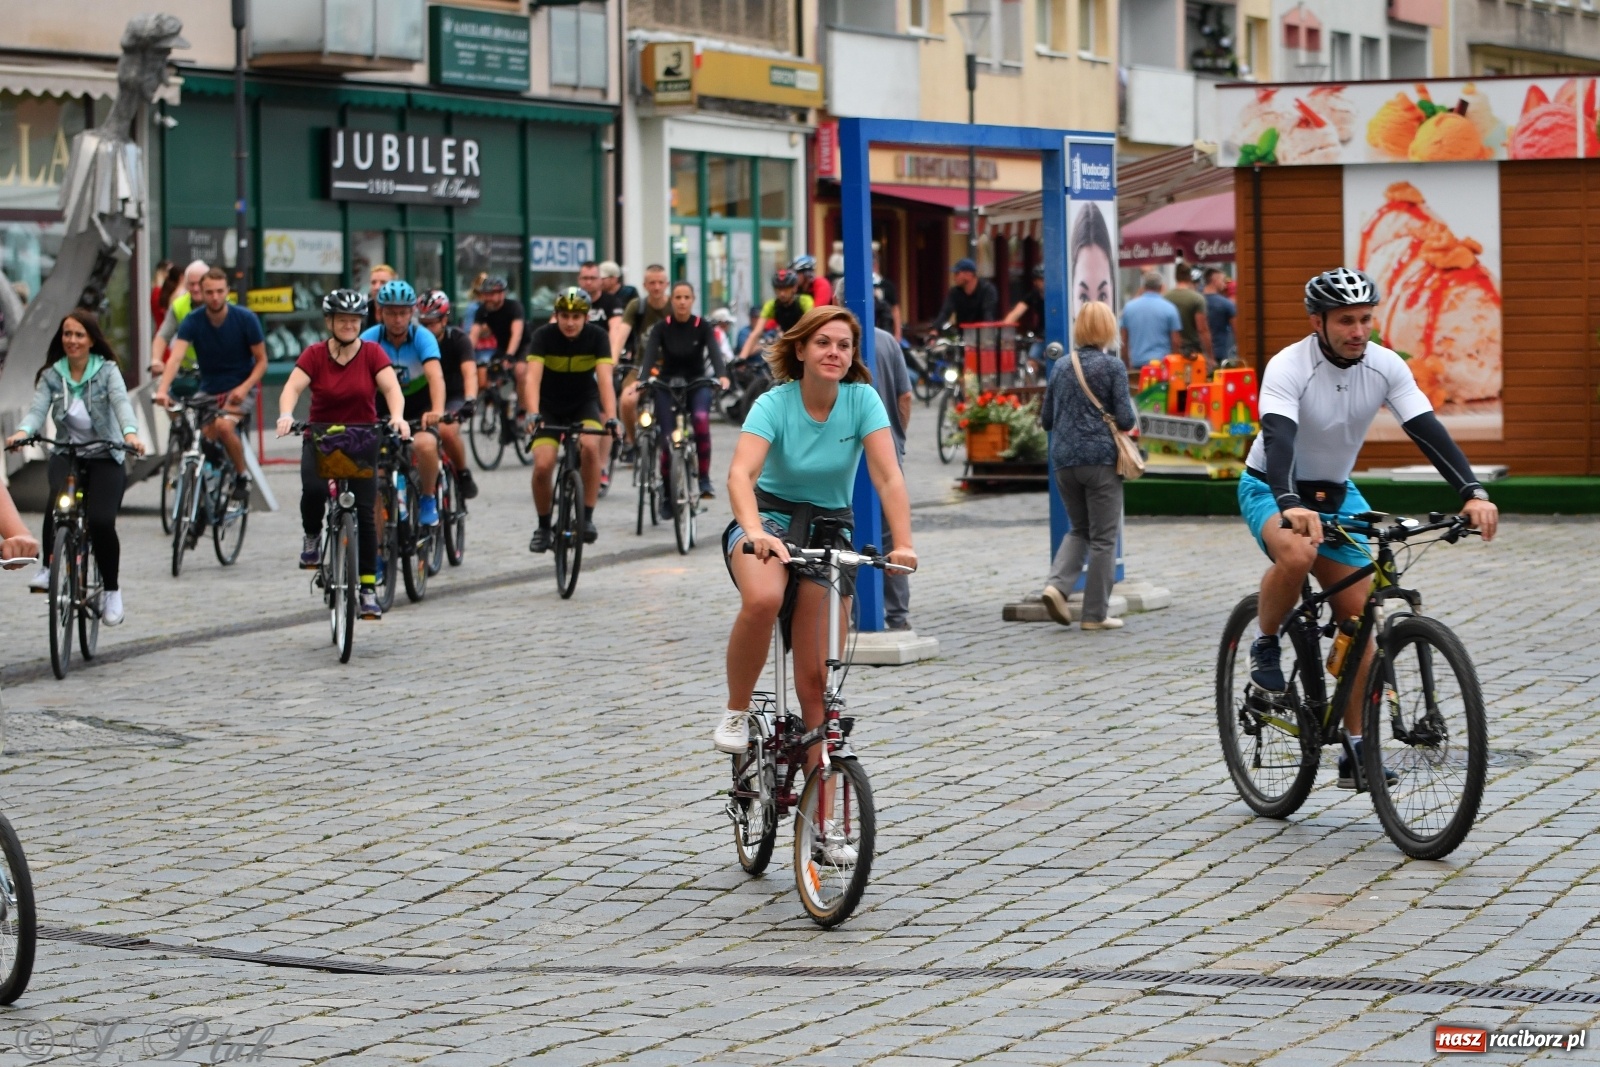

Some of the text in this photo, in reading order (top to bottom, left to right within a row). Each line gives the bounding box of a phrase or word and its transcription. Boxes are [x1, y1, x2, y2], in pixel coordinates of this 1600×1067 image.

[332, 129, 481, 177] JUBILER
[367, 178, 395, 195] 1989
[1082, 178, 1111, 191] Raciborskie
[531, 239, 588, 266] CASIO
